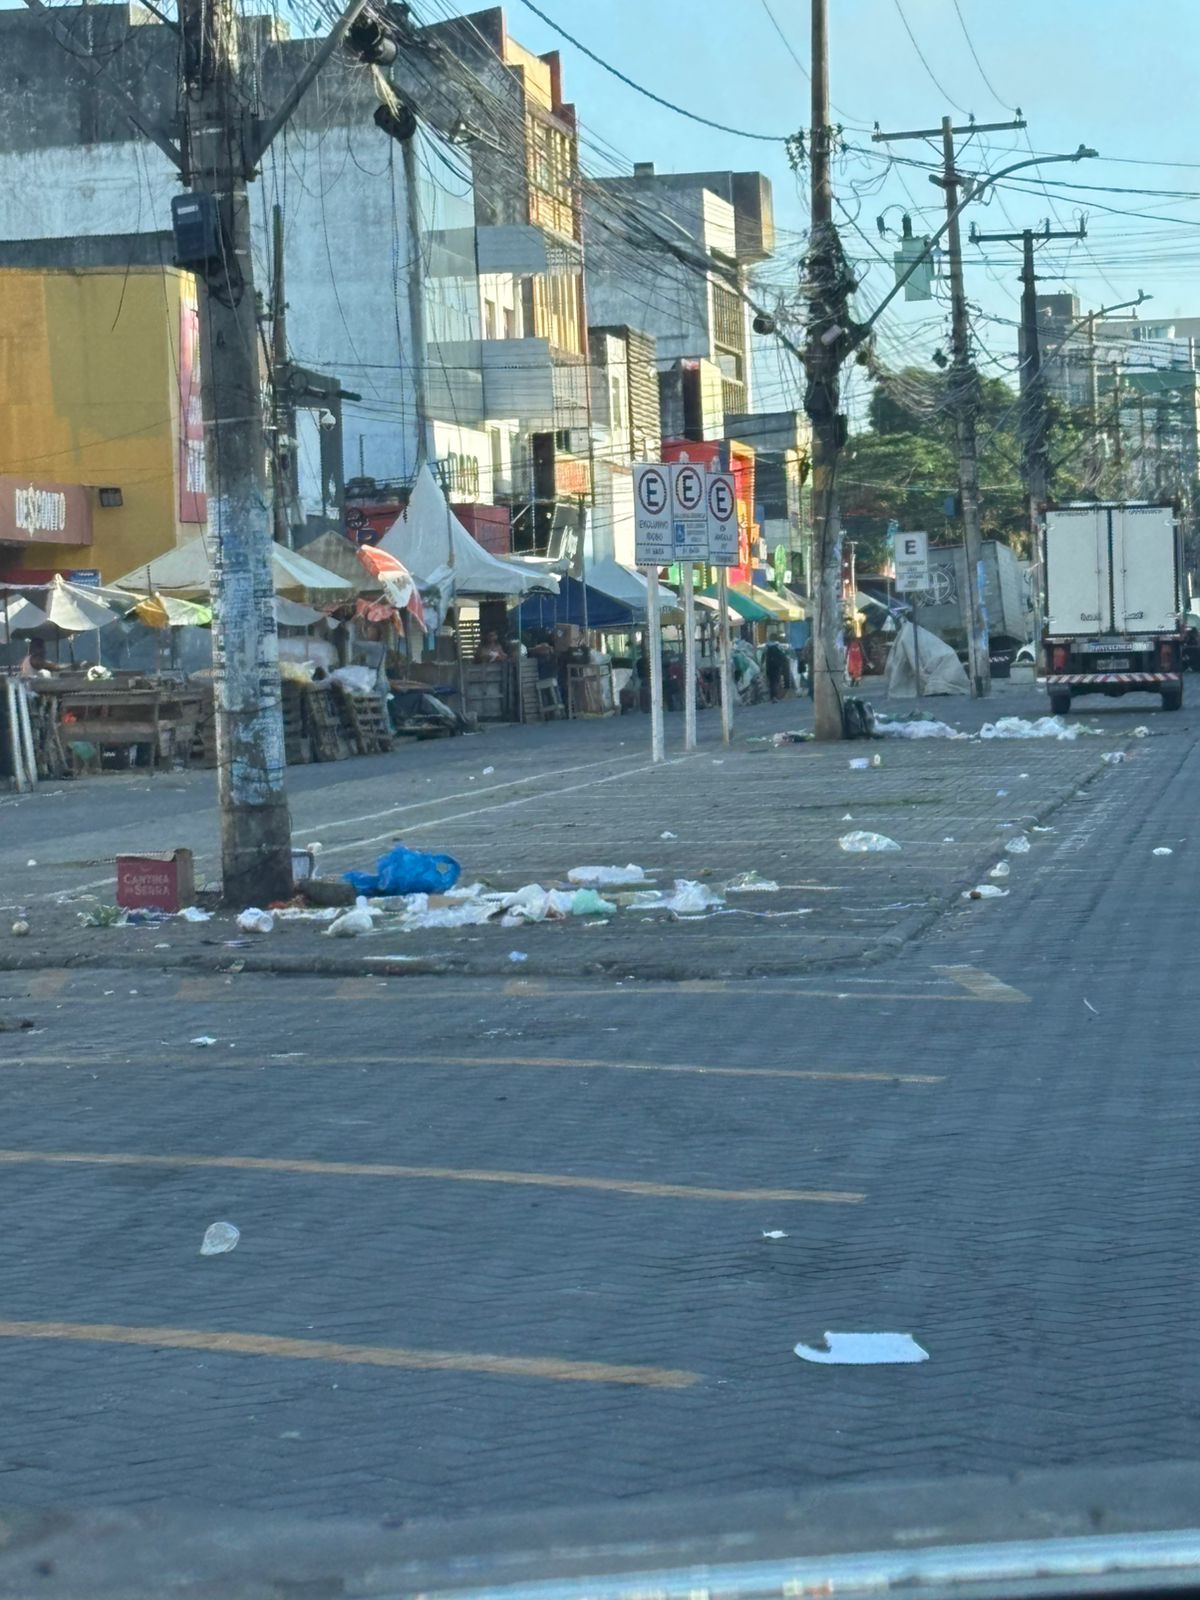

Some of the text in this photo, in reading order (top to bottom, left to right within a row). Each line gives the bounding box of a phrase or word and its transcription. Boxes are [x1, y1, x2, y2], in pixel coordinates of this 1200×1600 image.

[646, 478, 659, 506] E
[682, 475, 695, 502] E
[715, 487, 728, 513] E
[905, 540, 916, 555] E
